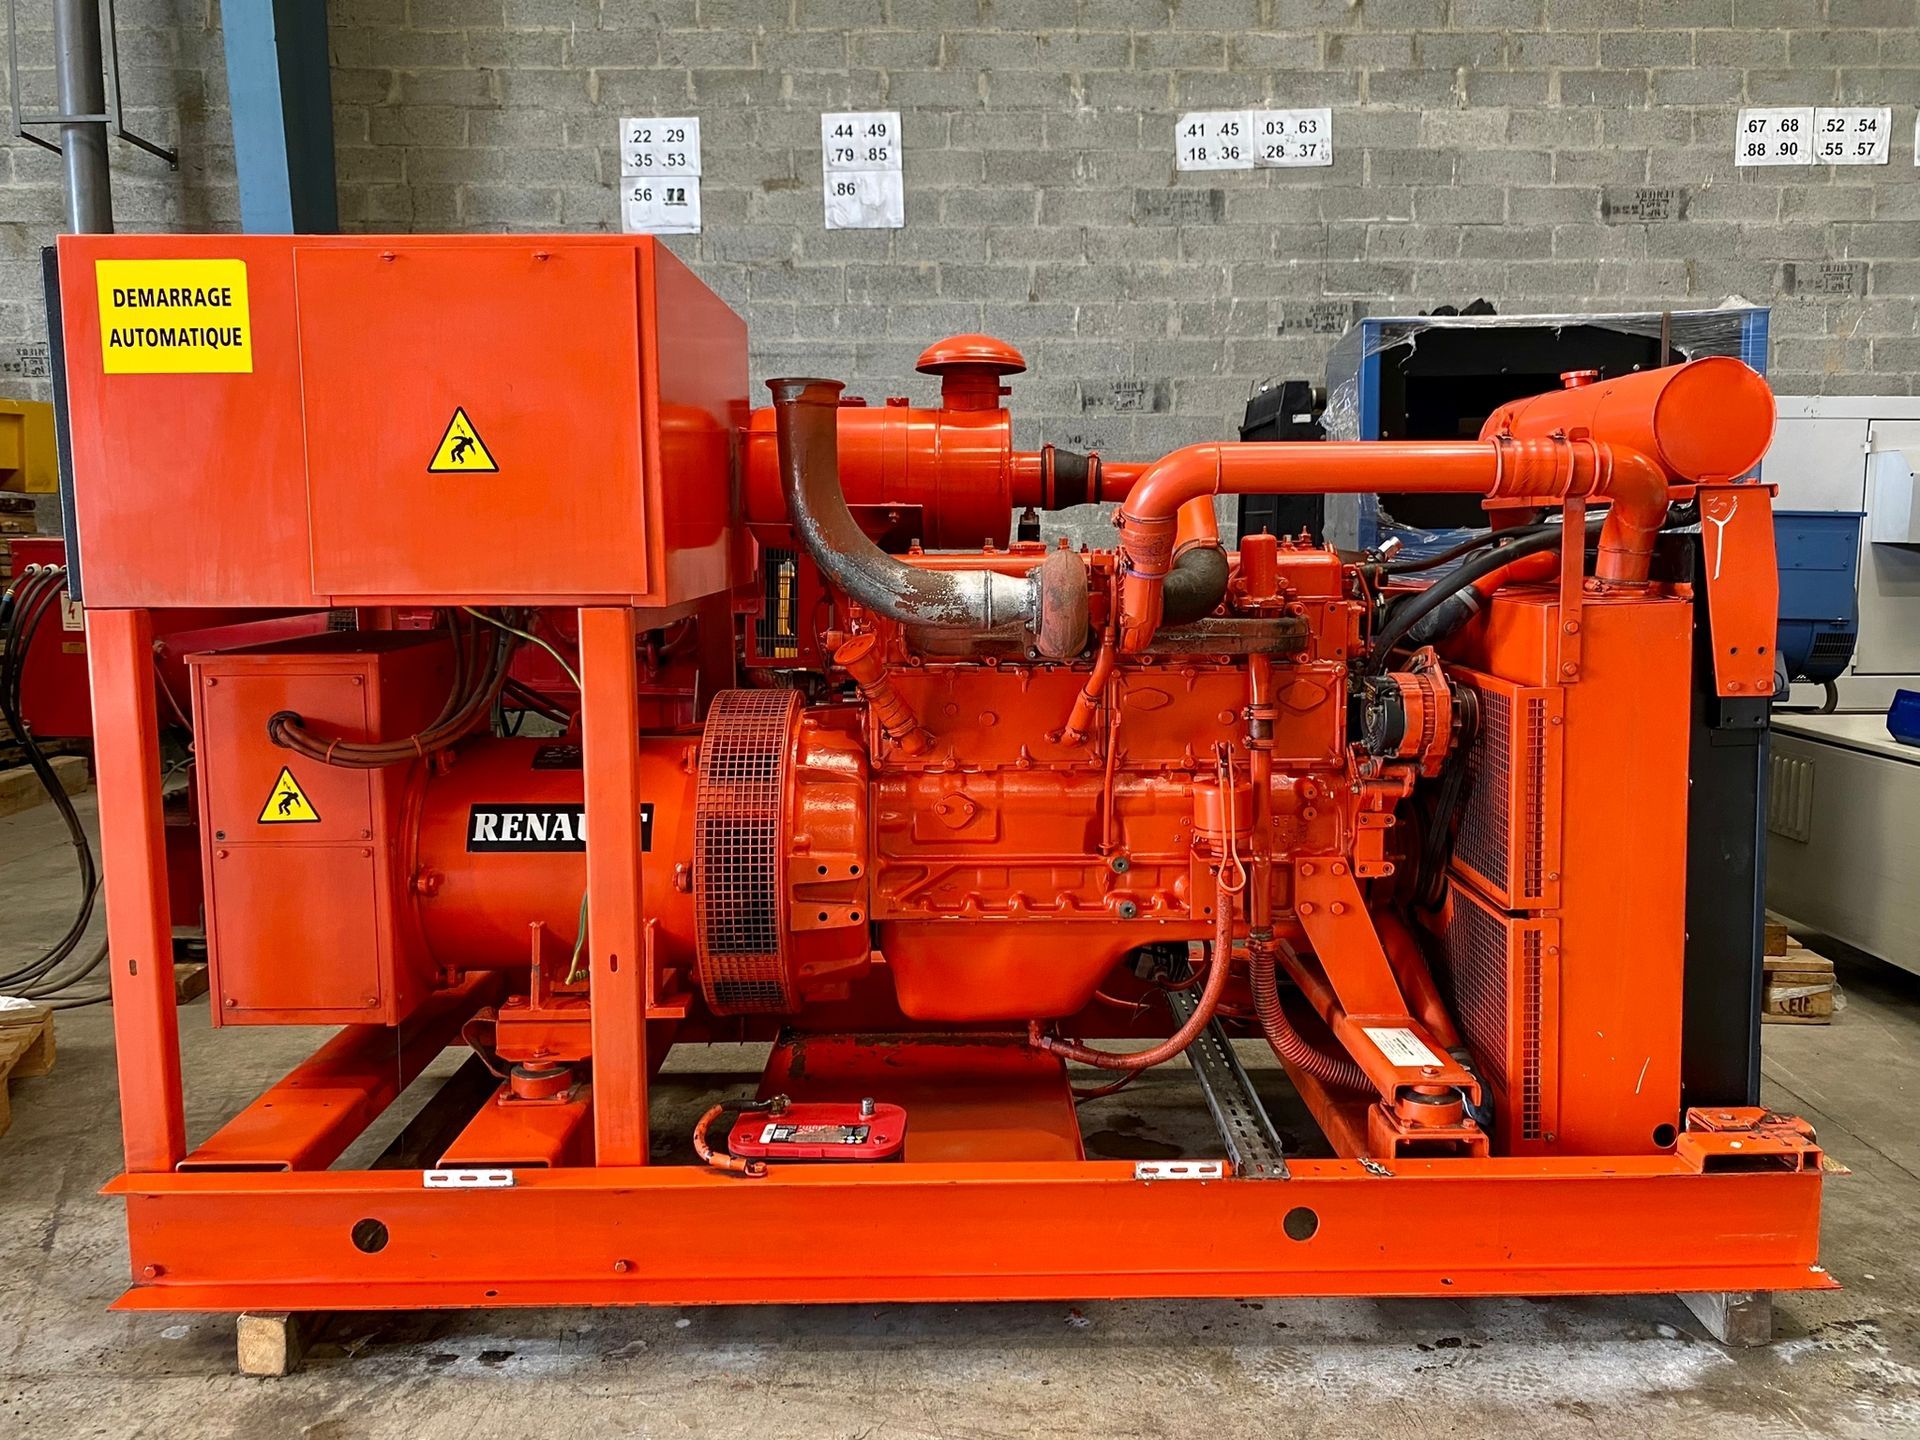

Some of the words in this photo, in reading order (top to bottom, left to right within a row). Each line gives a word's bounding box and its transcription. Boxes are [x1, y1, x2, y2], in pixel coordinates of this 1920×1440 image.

[830, 124, 853, 138] .44
[863, 123, 886, 137] .49
[1183, 123, 1205, 137] .41
[1216, 122, 1239, 136] .45
[1262, 121, 1285, 135] .03
[1294, 120, 1317, 134] .63
[1744, 119, 1767, 133] .67
[1776, 118, 1799, 133] .68
[1821, 118, 1845, 133] .52
[1853, 118, 1877, 133] .54
[629, 129, 652, 143] .22
[661, 128, 685, 143] .29
[831, 148, 854, 162] .79
[864, 147, 887, 161] .85
[1184, 147, 1207, 161] .18
[1217, 146, 1240, 160] .36
[1261, 144, 1285, 159] .28
[1294, 143, 1317, 158] .37
[1743, 142, 1766, 157] .88
[1775, 141, 1798, 156] .90
[1819, 142, 1844, 157] .55
[1852, 142, 1876, 156] .57
[629, 153, 653, 167] .35
[662, 152, 686, 167] .53
[630, 188, 653, 202] .56
[832, 182, 856, 196] .86
[113, 287, 232, 308] DEMARRAGE
[109, 327, 243, 350] AUTOMATIQUE
